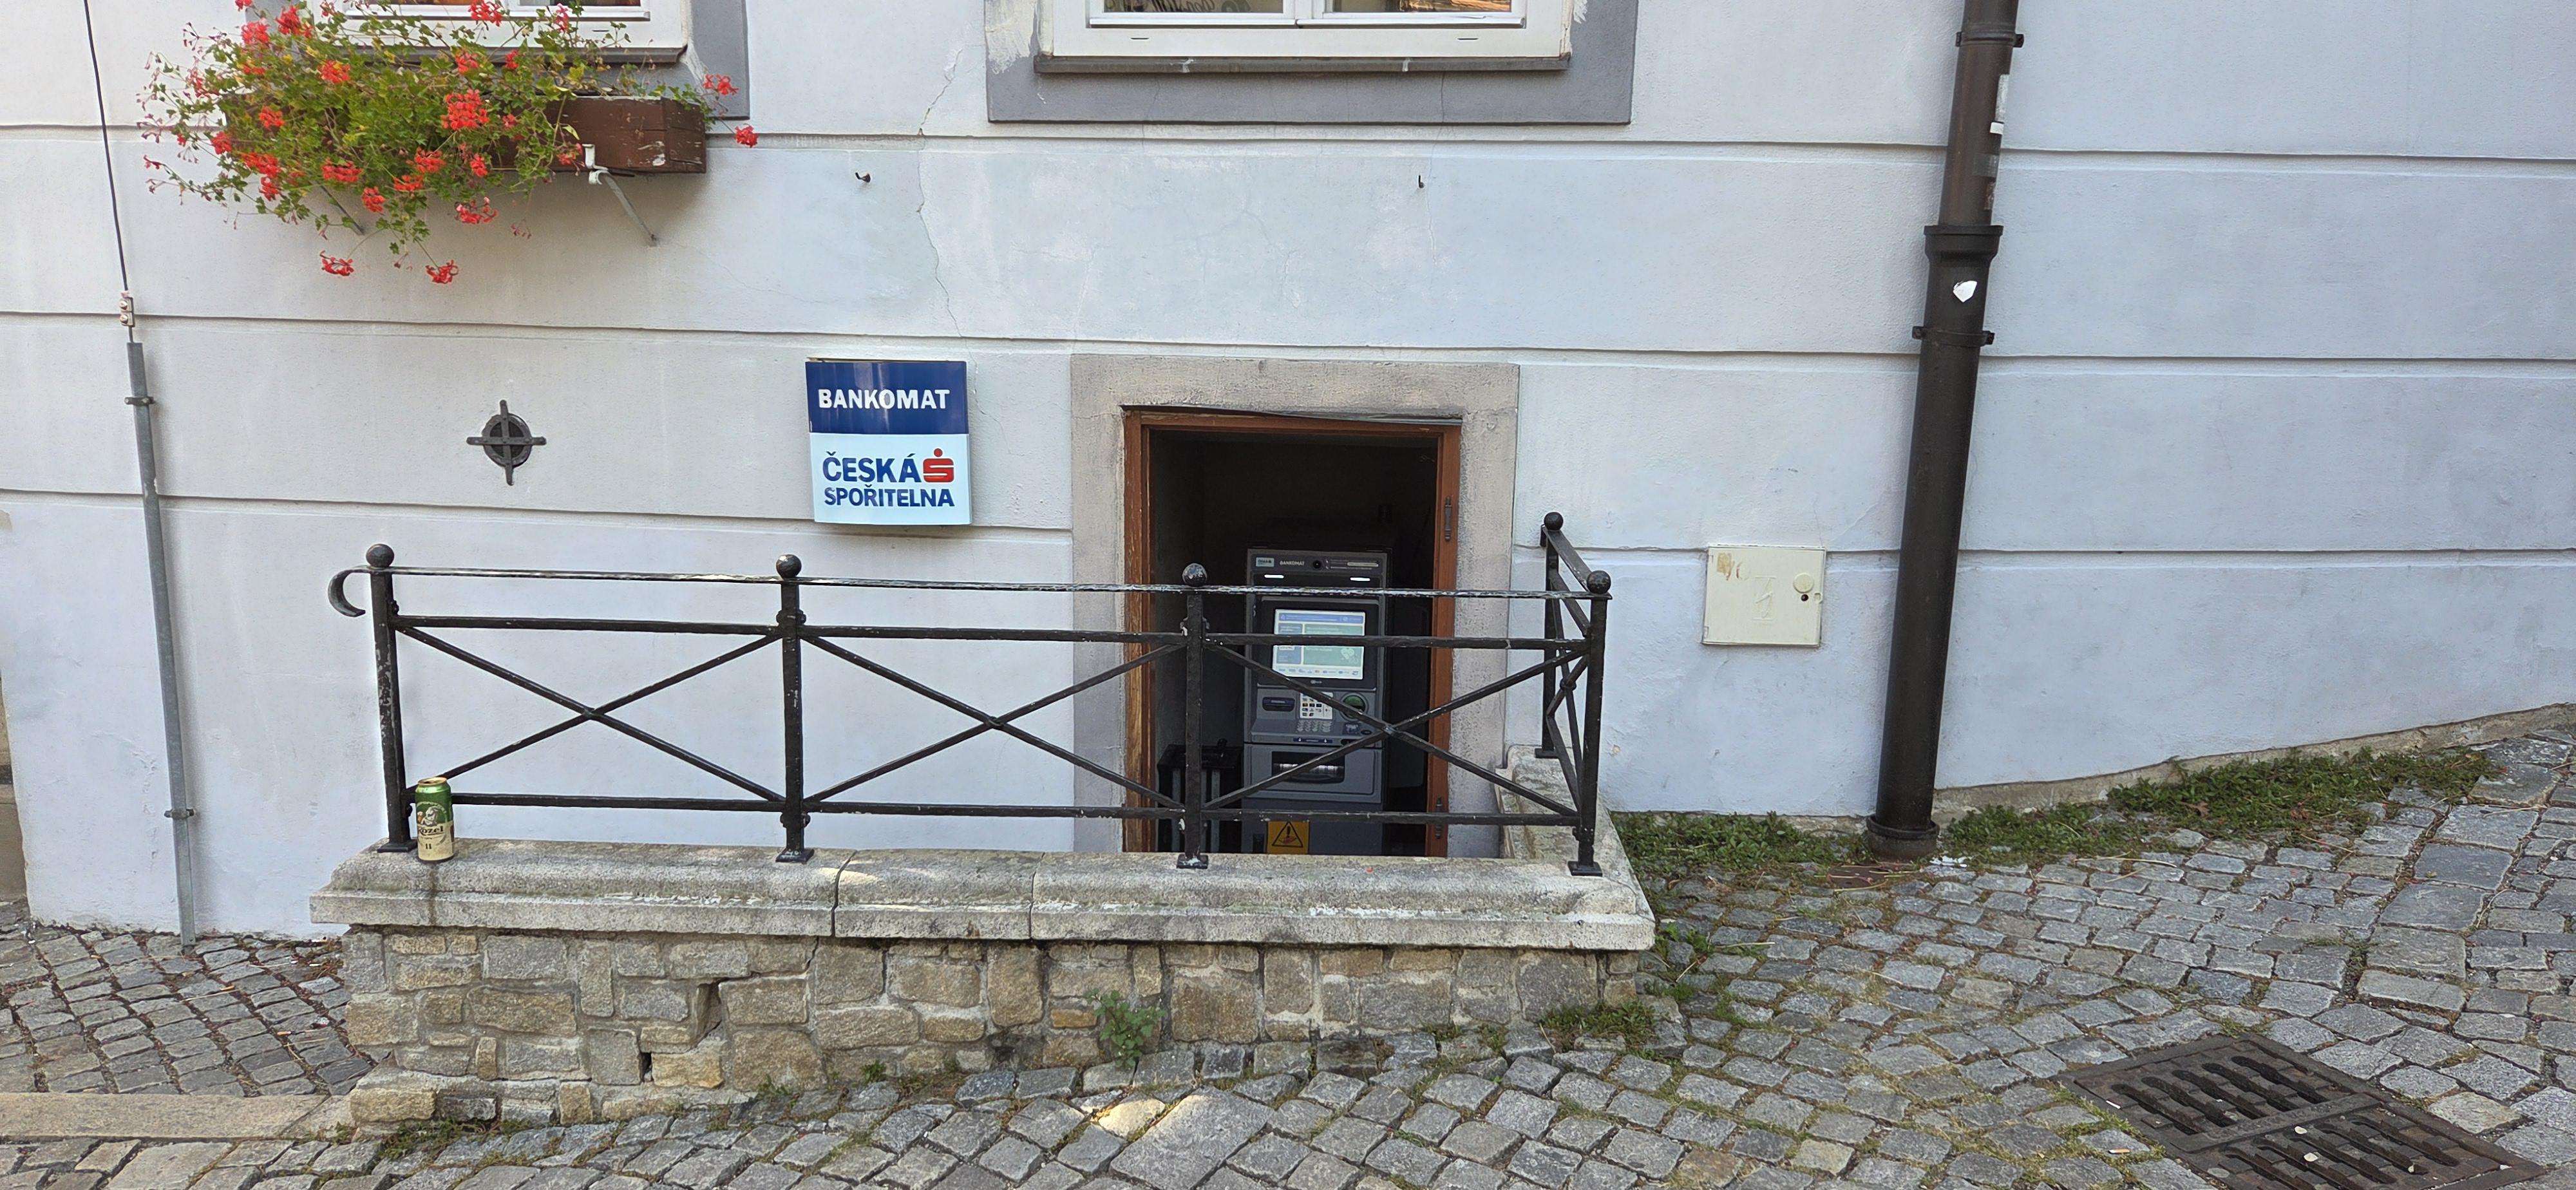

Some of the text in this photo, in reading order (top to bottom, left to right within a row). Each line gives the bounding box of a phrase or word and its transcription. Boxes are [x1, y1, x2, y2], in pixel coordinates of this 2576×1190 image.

[818, 389, 950, 409] BANKOMAT
[822, 451, 922, 483] ČESKÁ
[824, 484, 955, 507] SPOŘITELNA
[417, 826, 444, 836] Kozel
